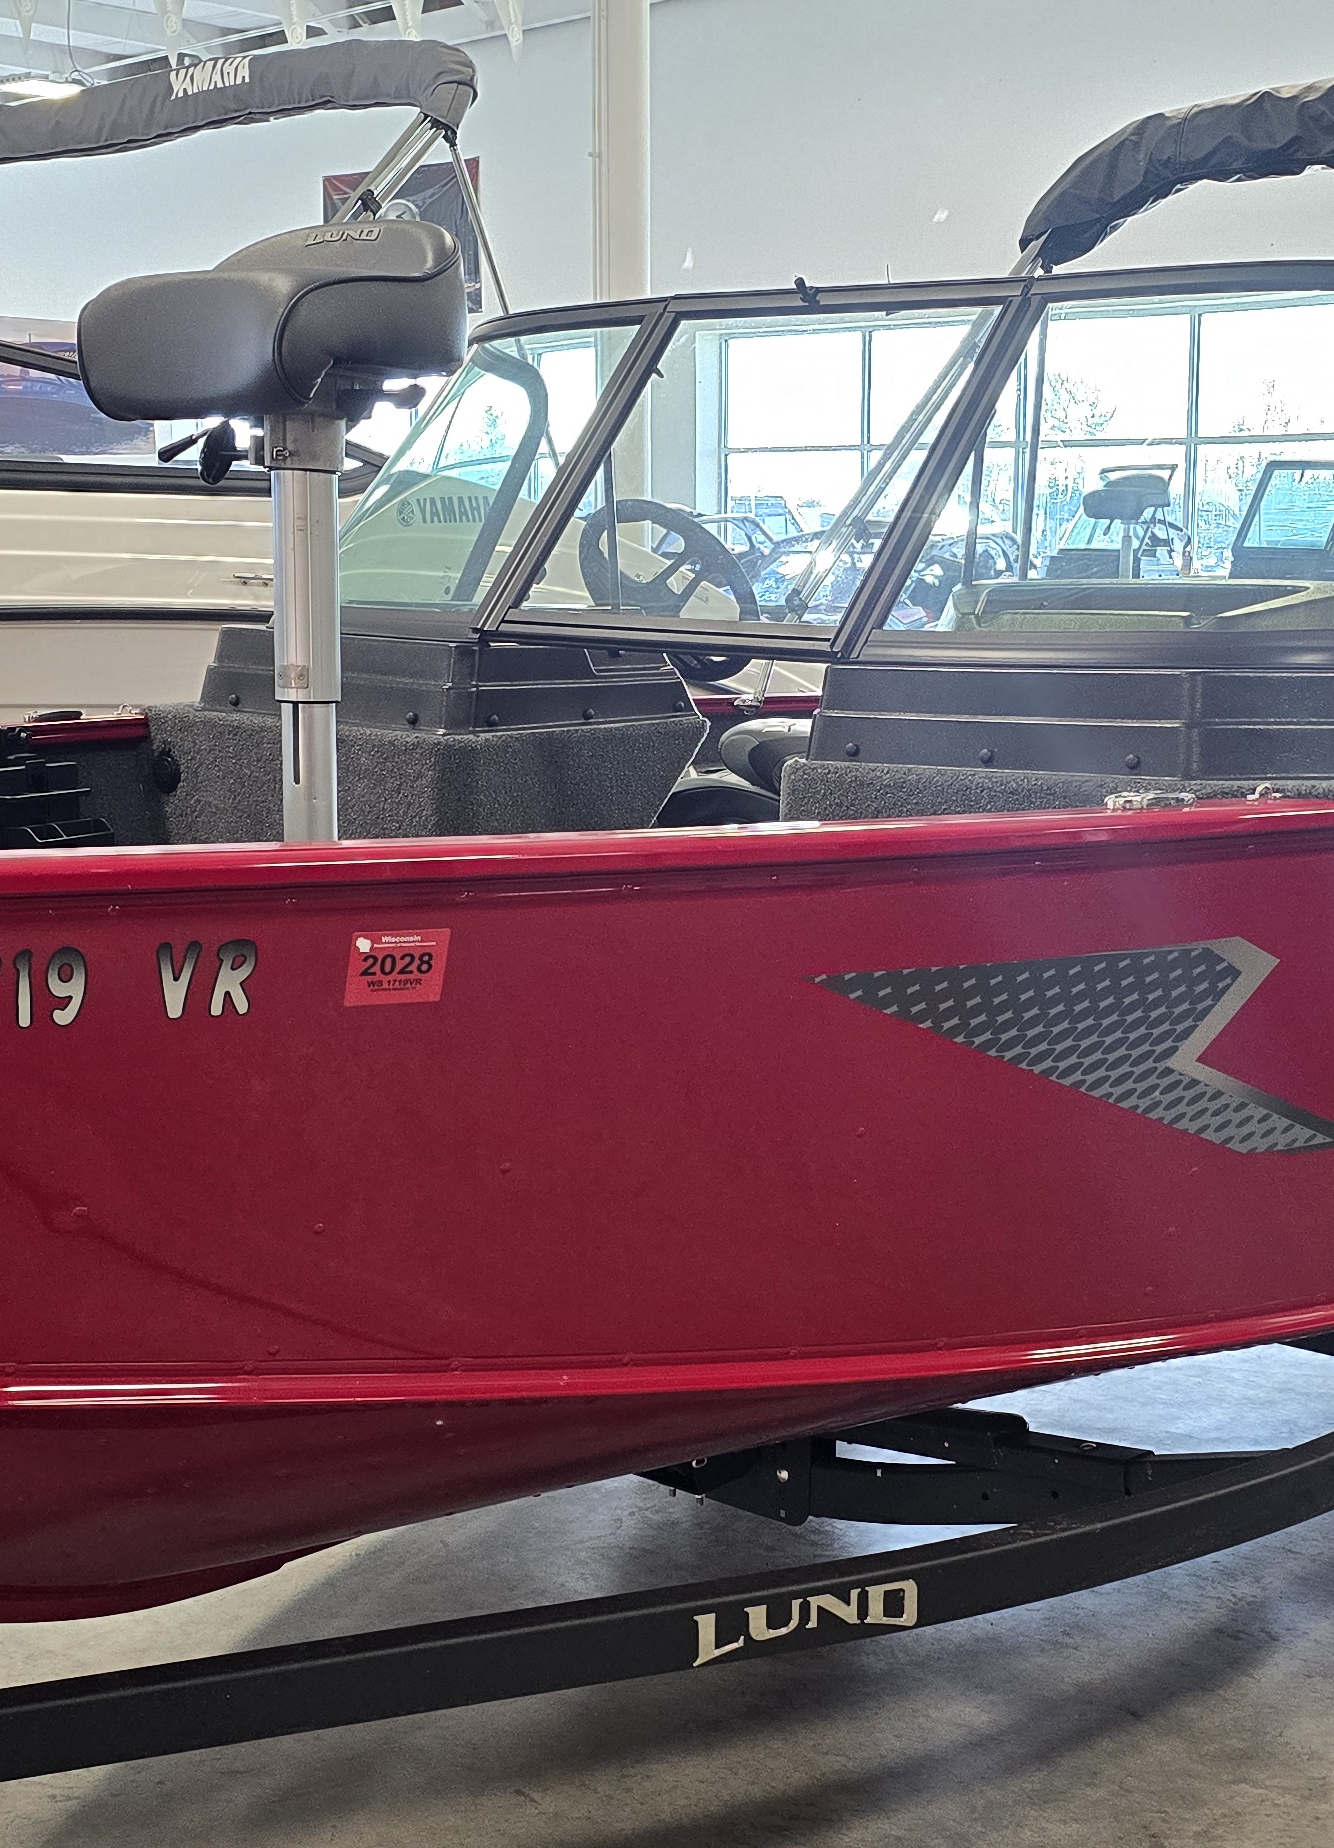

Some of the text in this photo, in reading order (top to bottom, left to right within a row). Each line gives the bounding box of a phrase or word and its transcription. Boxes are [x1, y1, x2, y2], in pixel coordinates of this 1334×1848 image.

[170, 55, 253, 100] YAMAHA
[305, 227, 382, 247] LUND
[381, 934, 422, 943] Wisconsin
[155, 937, 258, 1020] VR
[359, 952, 435, 977] 2028
[692, 1578, 918, 1667] LUND
